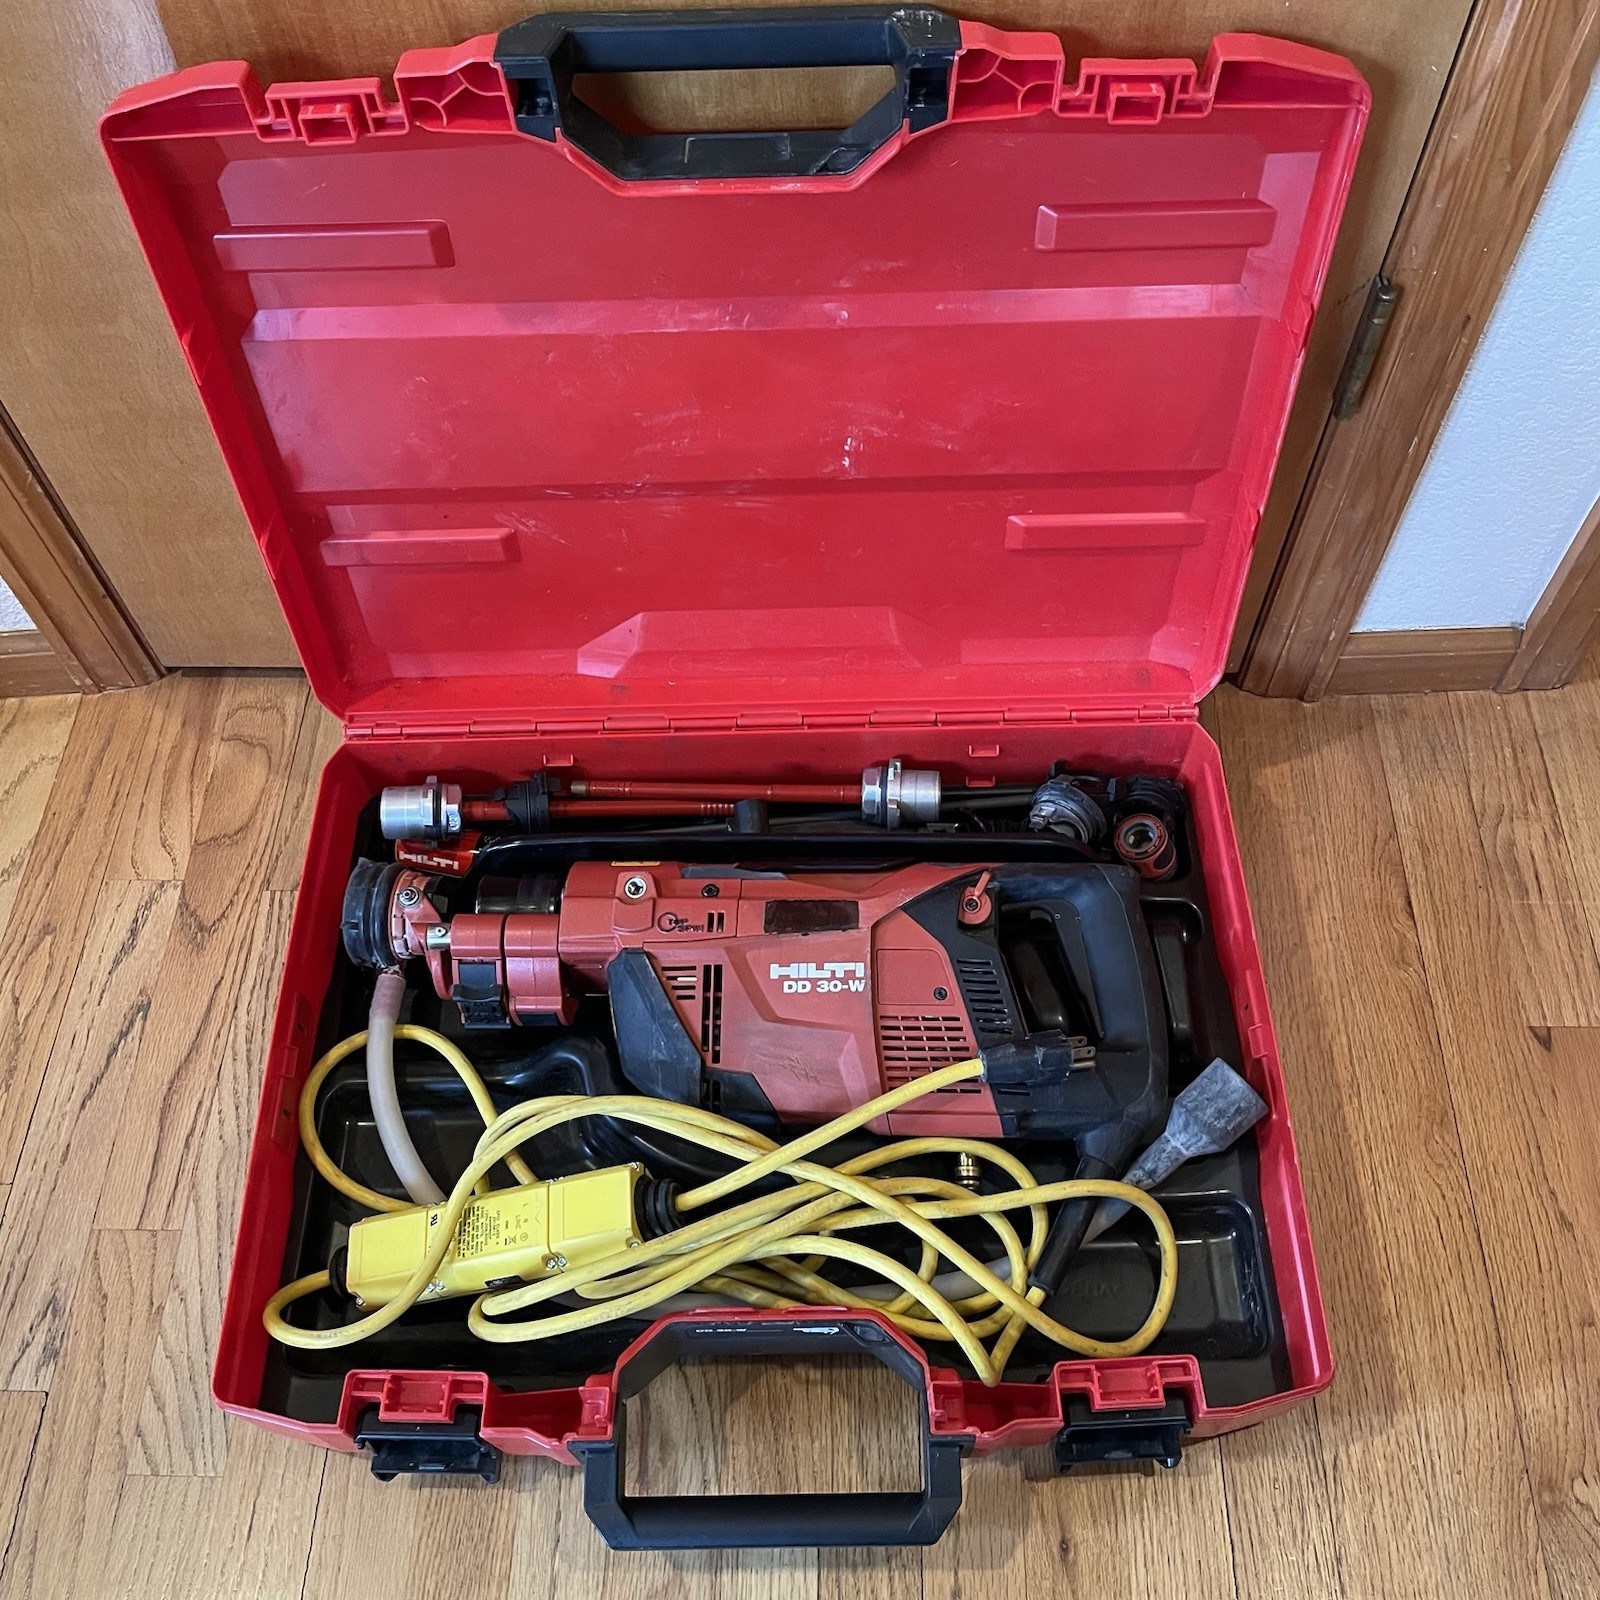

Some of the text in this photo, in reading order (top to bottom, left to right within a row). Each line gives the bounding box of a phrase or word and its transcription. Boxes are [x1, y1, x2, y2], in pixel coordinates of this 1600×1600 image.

[398, 850, 460, 870] HILTI
[769, 962, 865, 979] HILTI
[783, 979, 866, 993] DD 30-W
